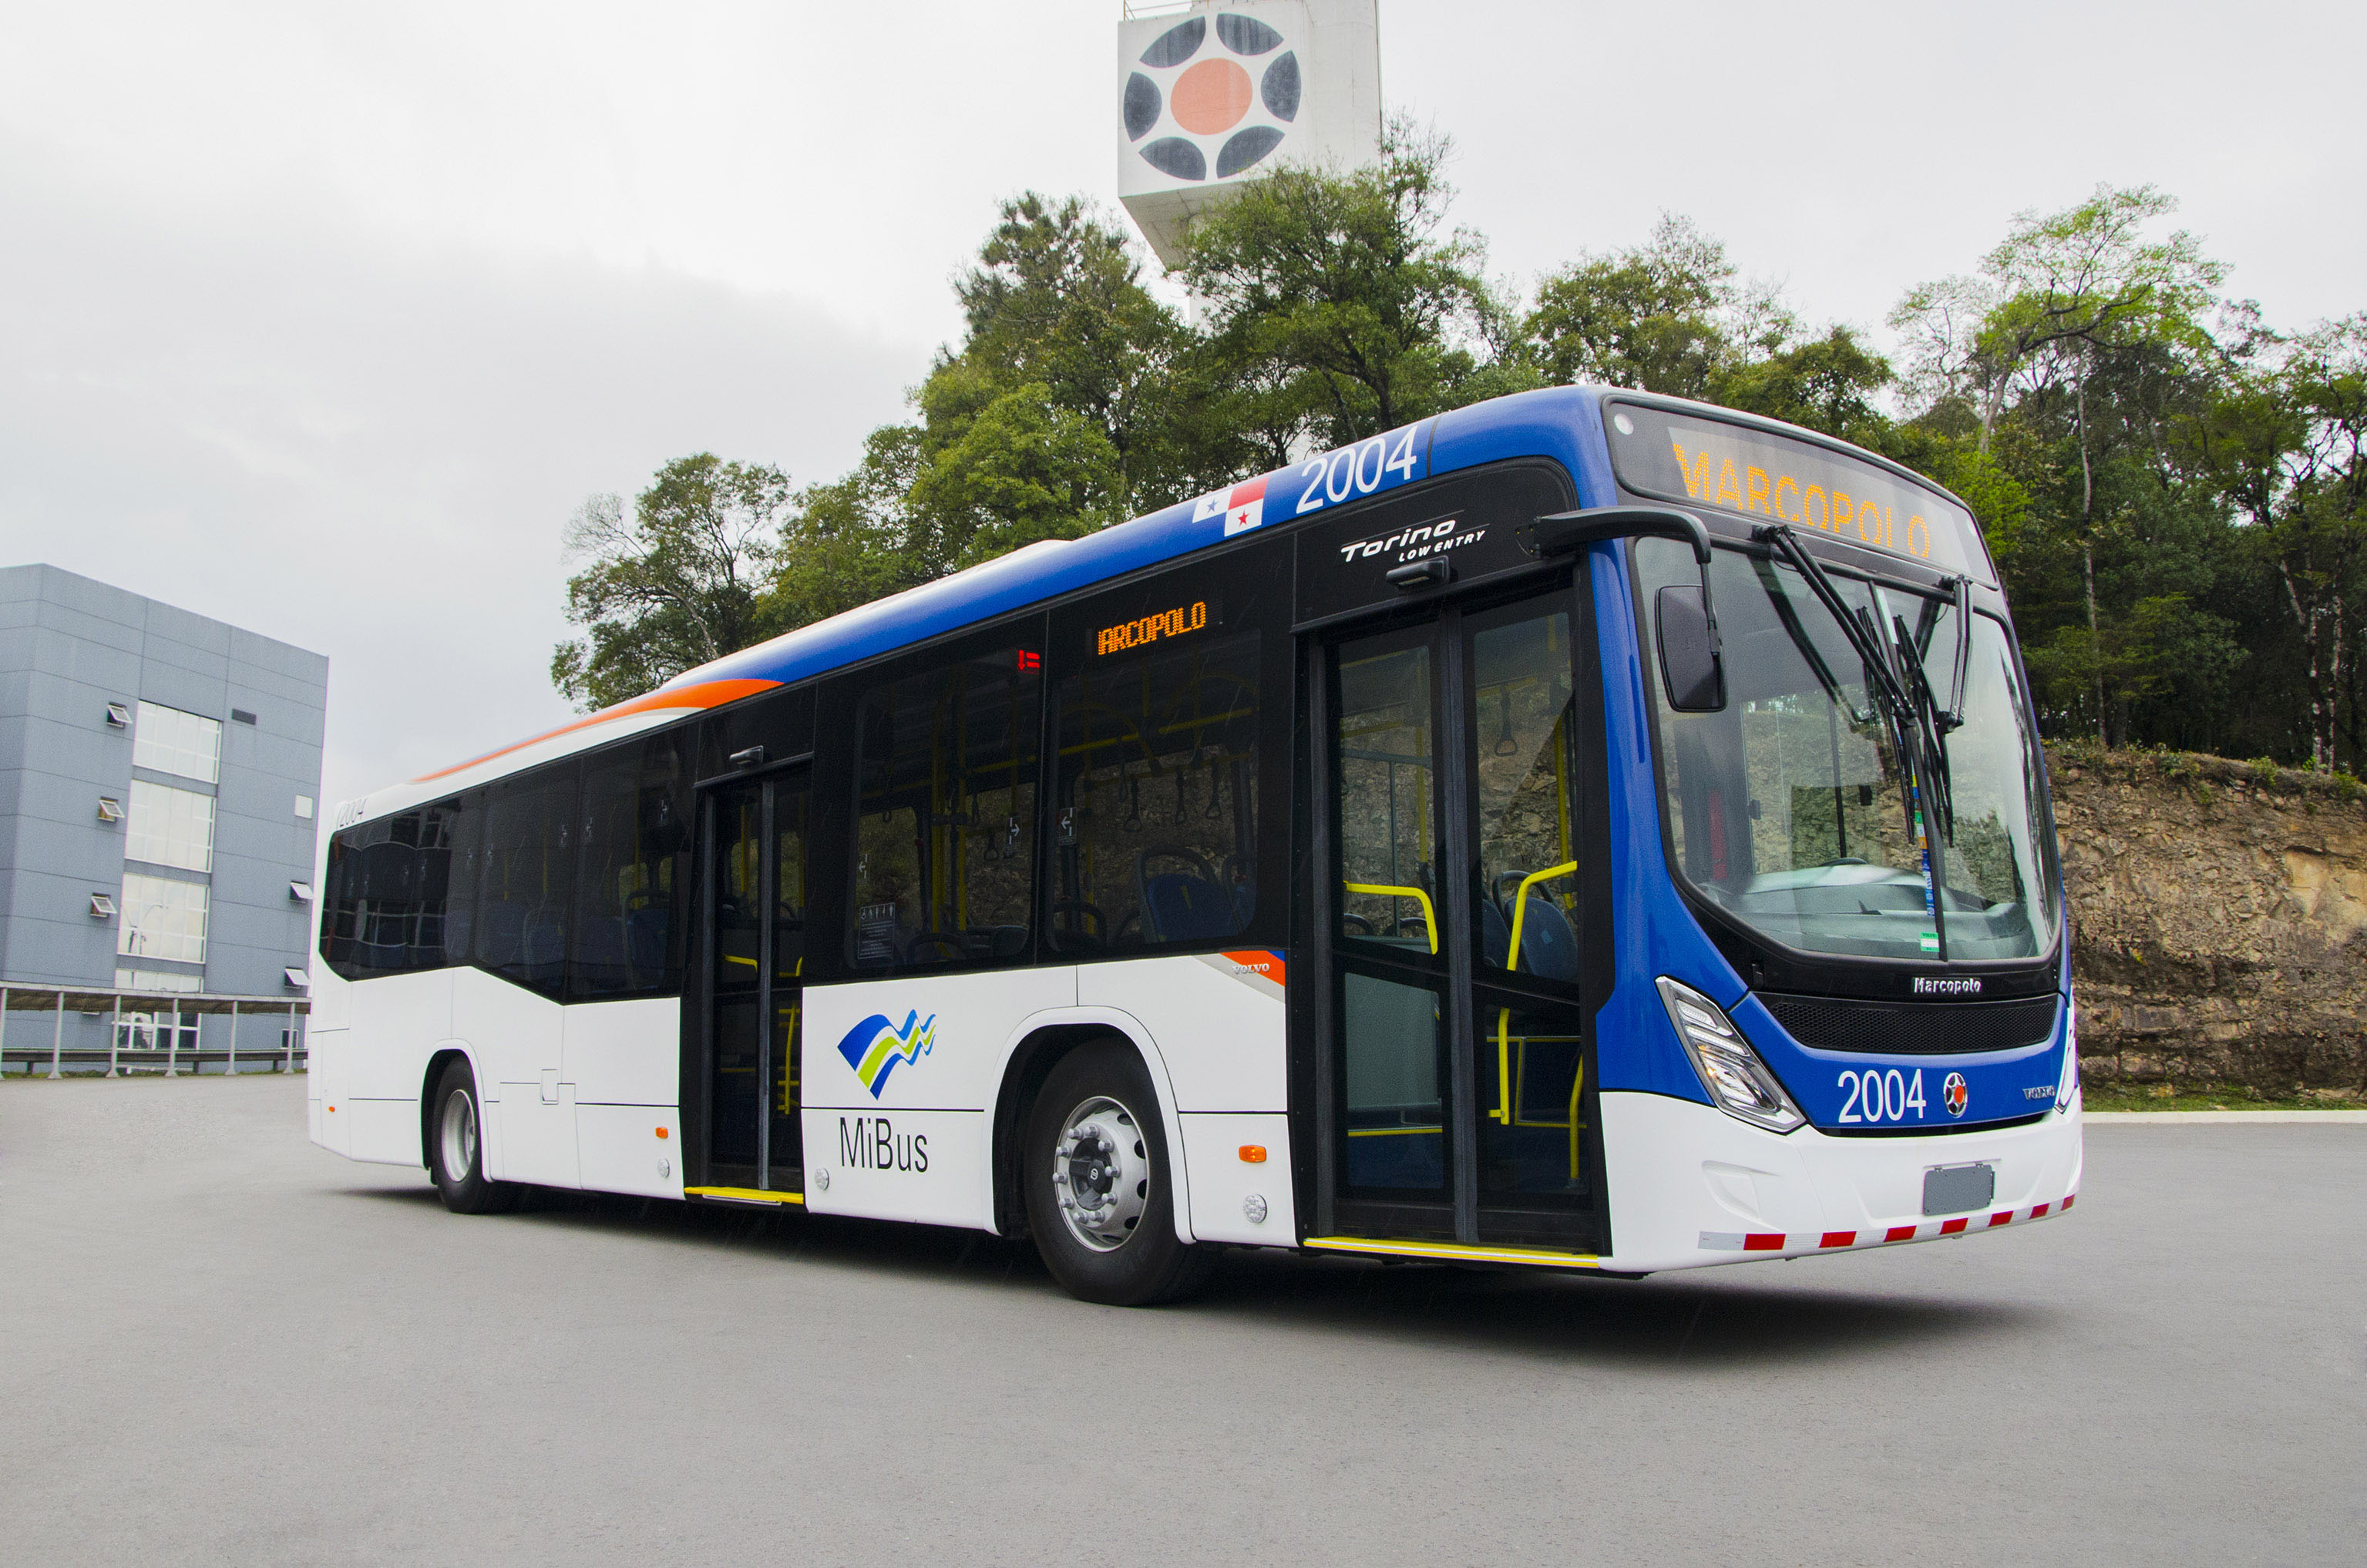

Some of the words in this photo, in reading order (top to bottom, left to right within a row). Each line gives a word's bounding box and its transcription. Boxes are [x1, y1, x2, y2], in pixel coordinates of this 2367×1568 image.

[1296, 425, 1419, 514] 2004
[1673, 443, 1930, 559] MARCOPOLO
[1340, 519, 1456, 562] Torino
[1399, 545, 1431, 562] LOW
[1434, 529, 1486, 553] ENTRY
[1098, 601, 1206, 656] ARCOPOLO
[1232, 962, 1270, 975] VOLVO
[1913, 977, 1982, 995] Marcopolo
[1837, 1068, 1927, 1123] 2004
[2022, 1085, 2056, 1100] VOLVO
[839, 1116, 929, 1173] MiBus
